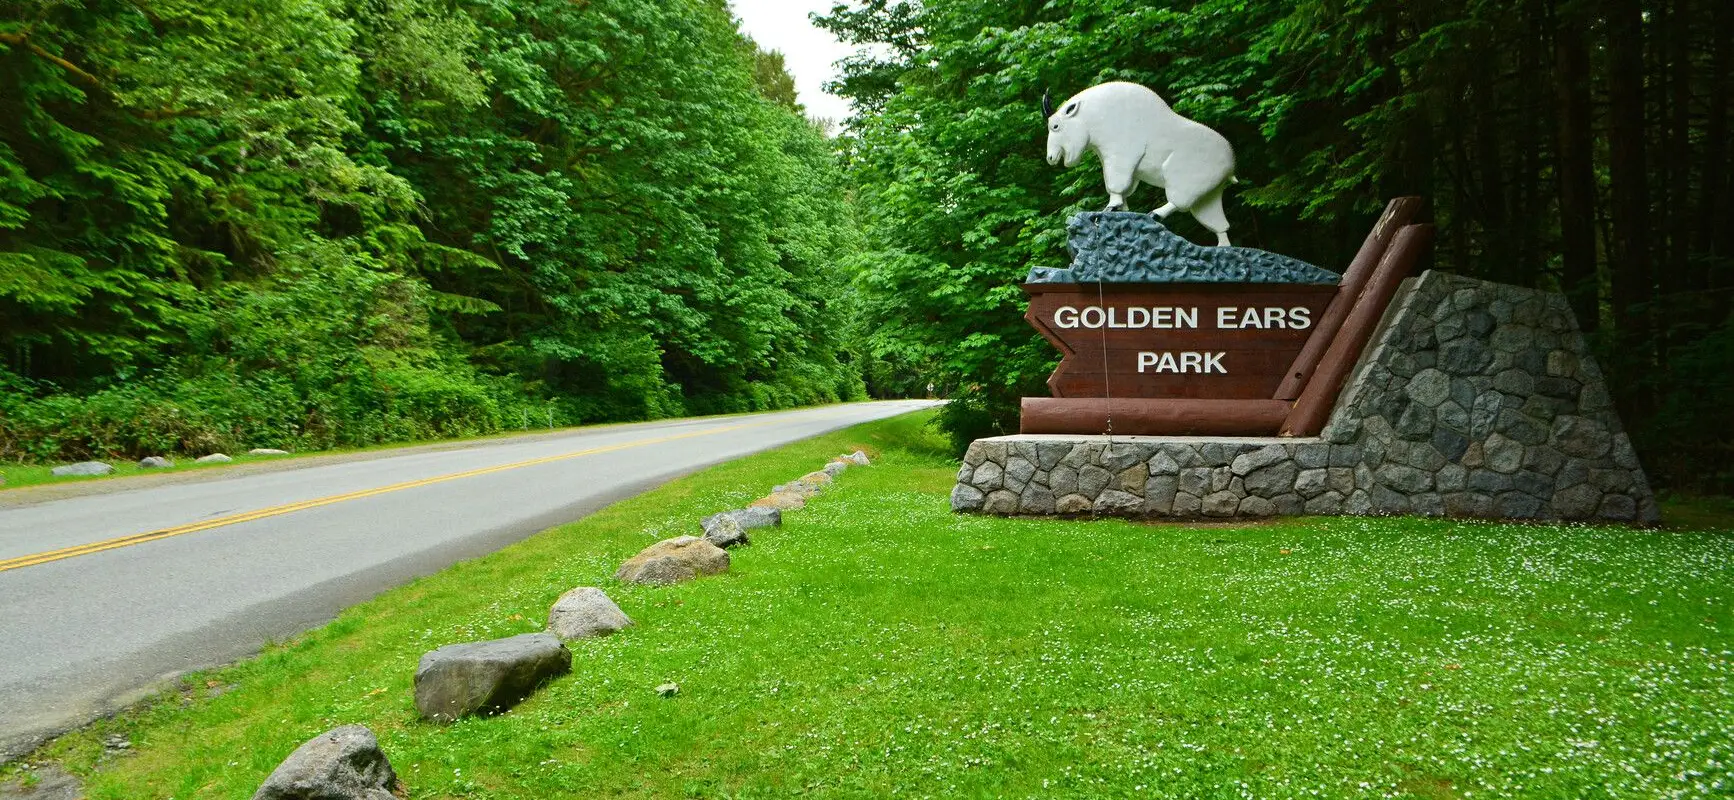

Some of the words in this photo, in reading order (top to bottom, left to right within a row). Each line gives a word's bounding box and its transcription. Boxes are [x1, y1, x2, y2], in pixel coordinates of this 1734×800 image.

[1053, 306, 1199, 329] GOLDEN
[1216, 306, 1312, 330] EARS
[1137, 351, 1228, 374] PARK
